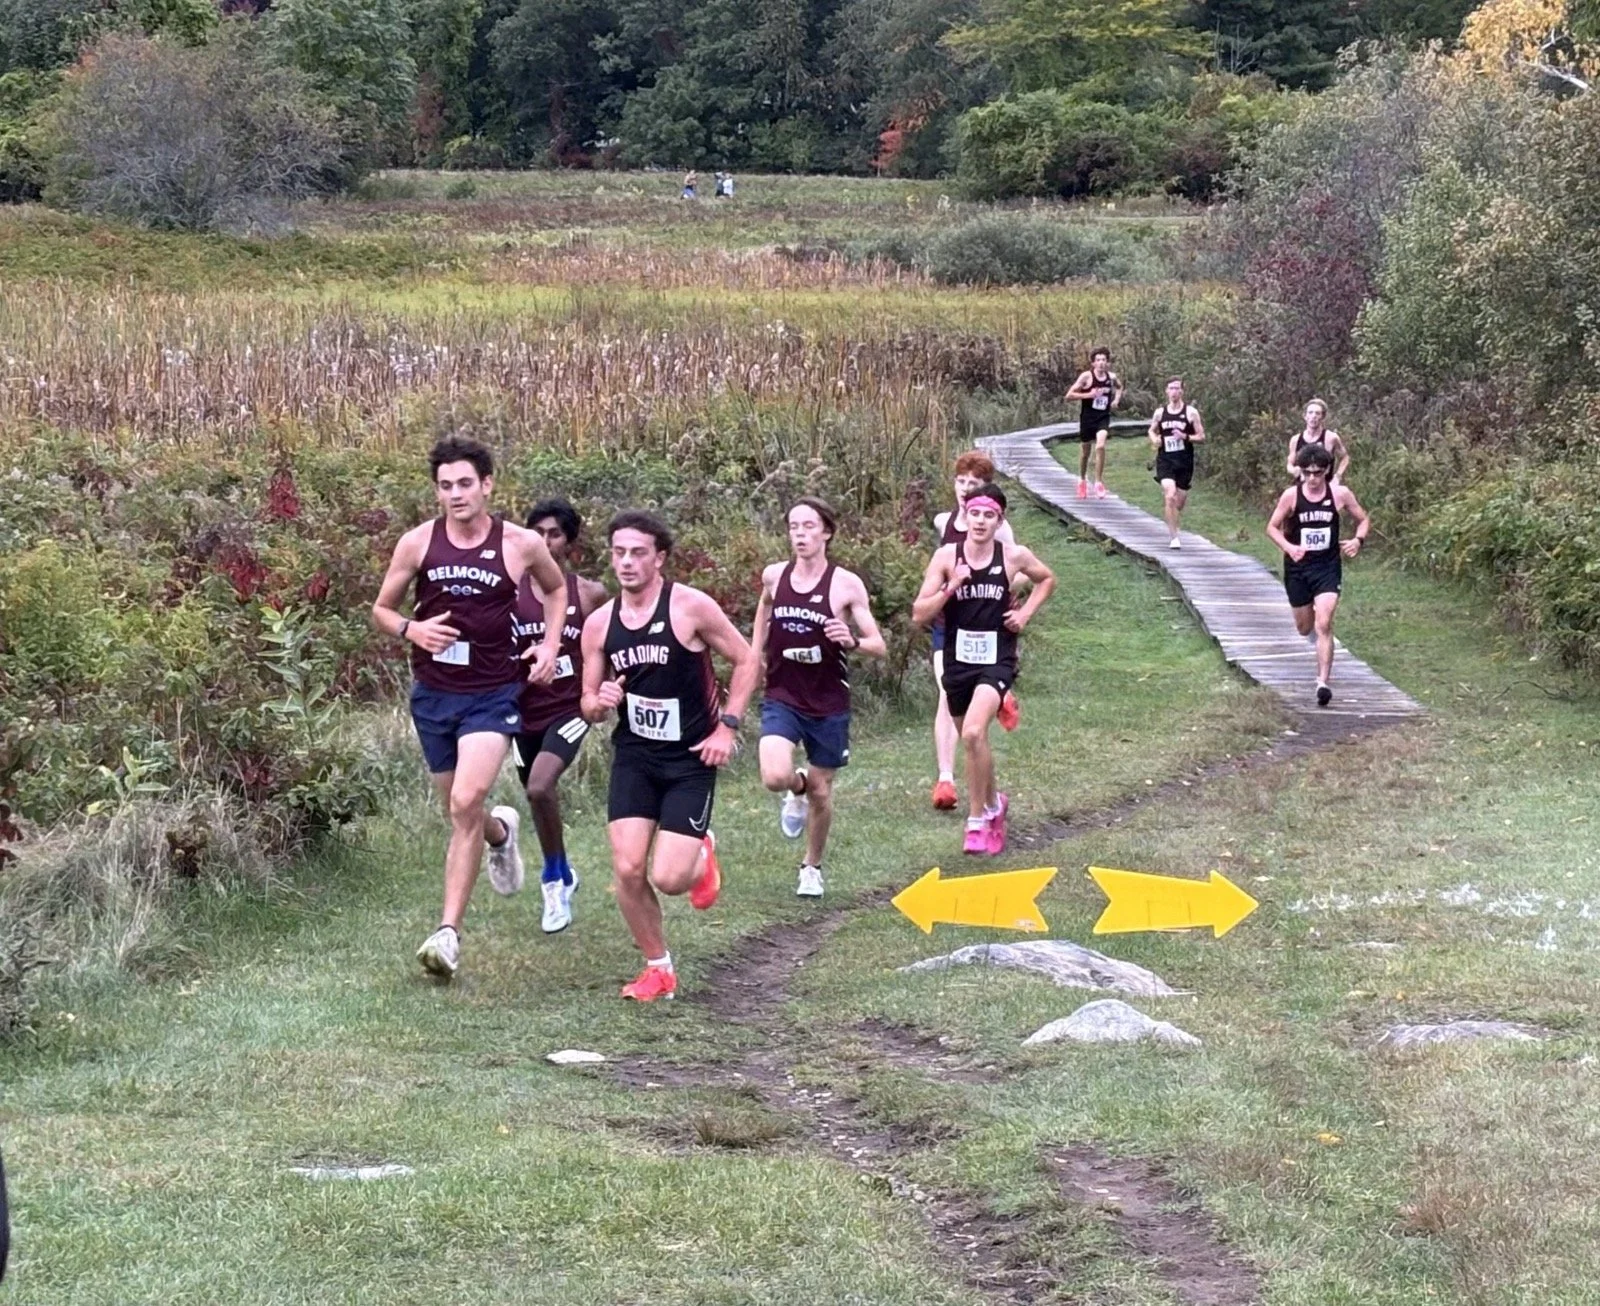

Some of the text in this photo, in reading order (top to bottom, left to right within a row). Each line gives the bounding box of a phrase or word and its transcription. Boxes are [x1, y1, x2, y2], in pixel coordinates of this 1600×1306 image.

[427, 565, 502, 587] BELMONT
[955, 583, 1004, 601] READING
[774, 606, 828, 625] BELMONT
[518, 622, 581, 640] BELNT
[792, 650, 813, 661] 164
[963, 640, 987, 653] 513
[610, 644, 670, 672] READING
[635, 705, 670, 730] 507
